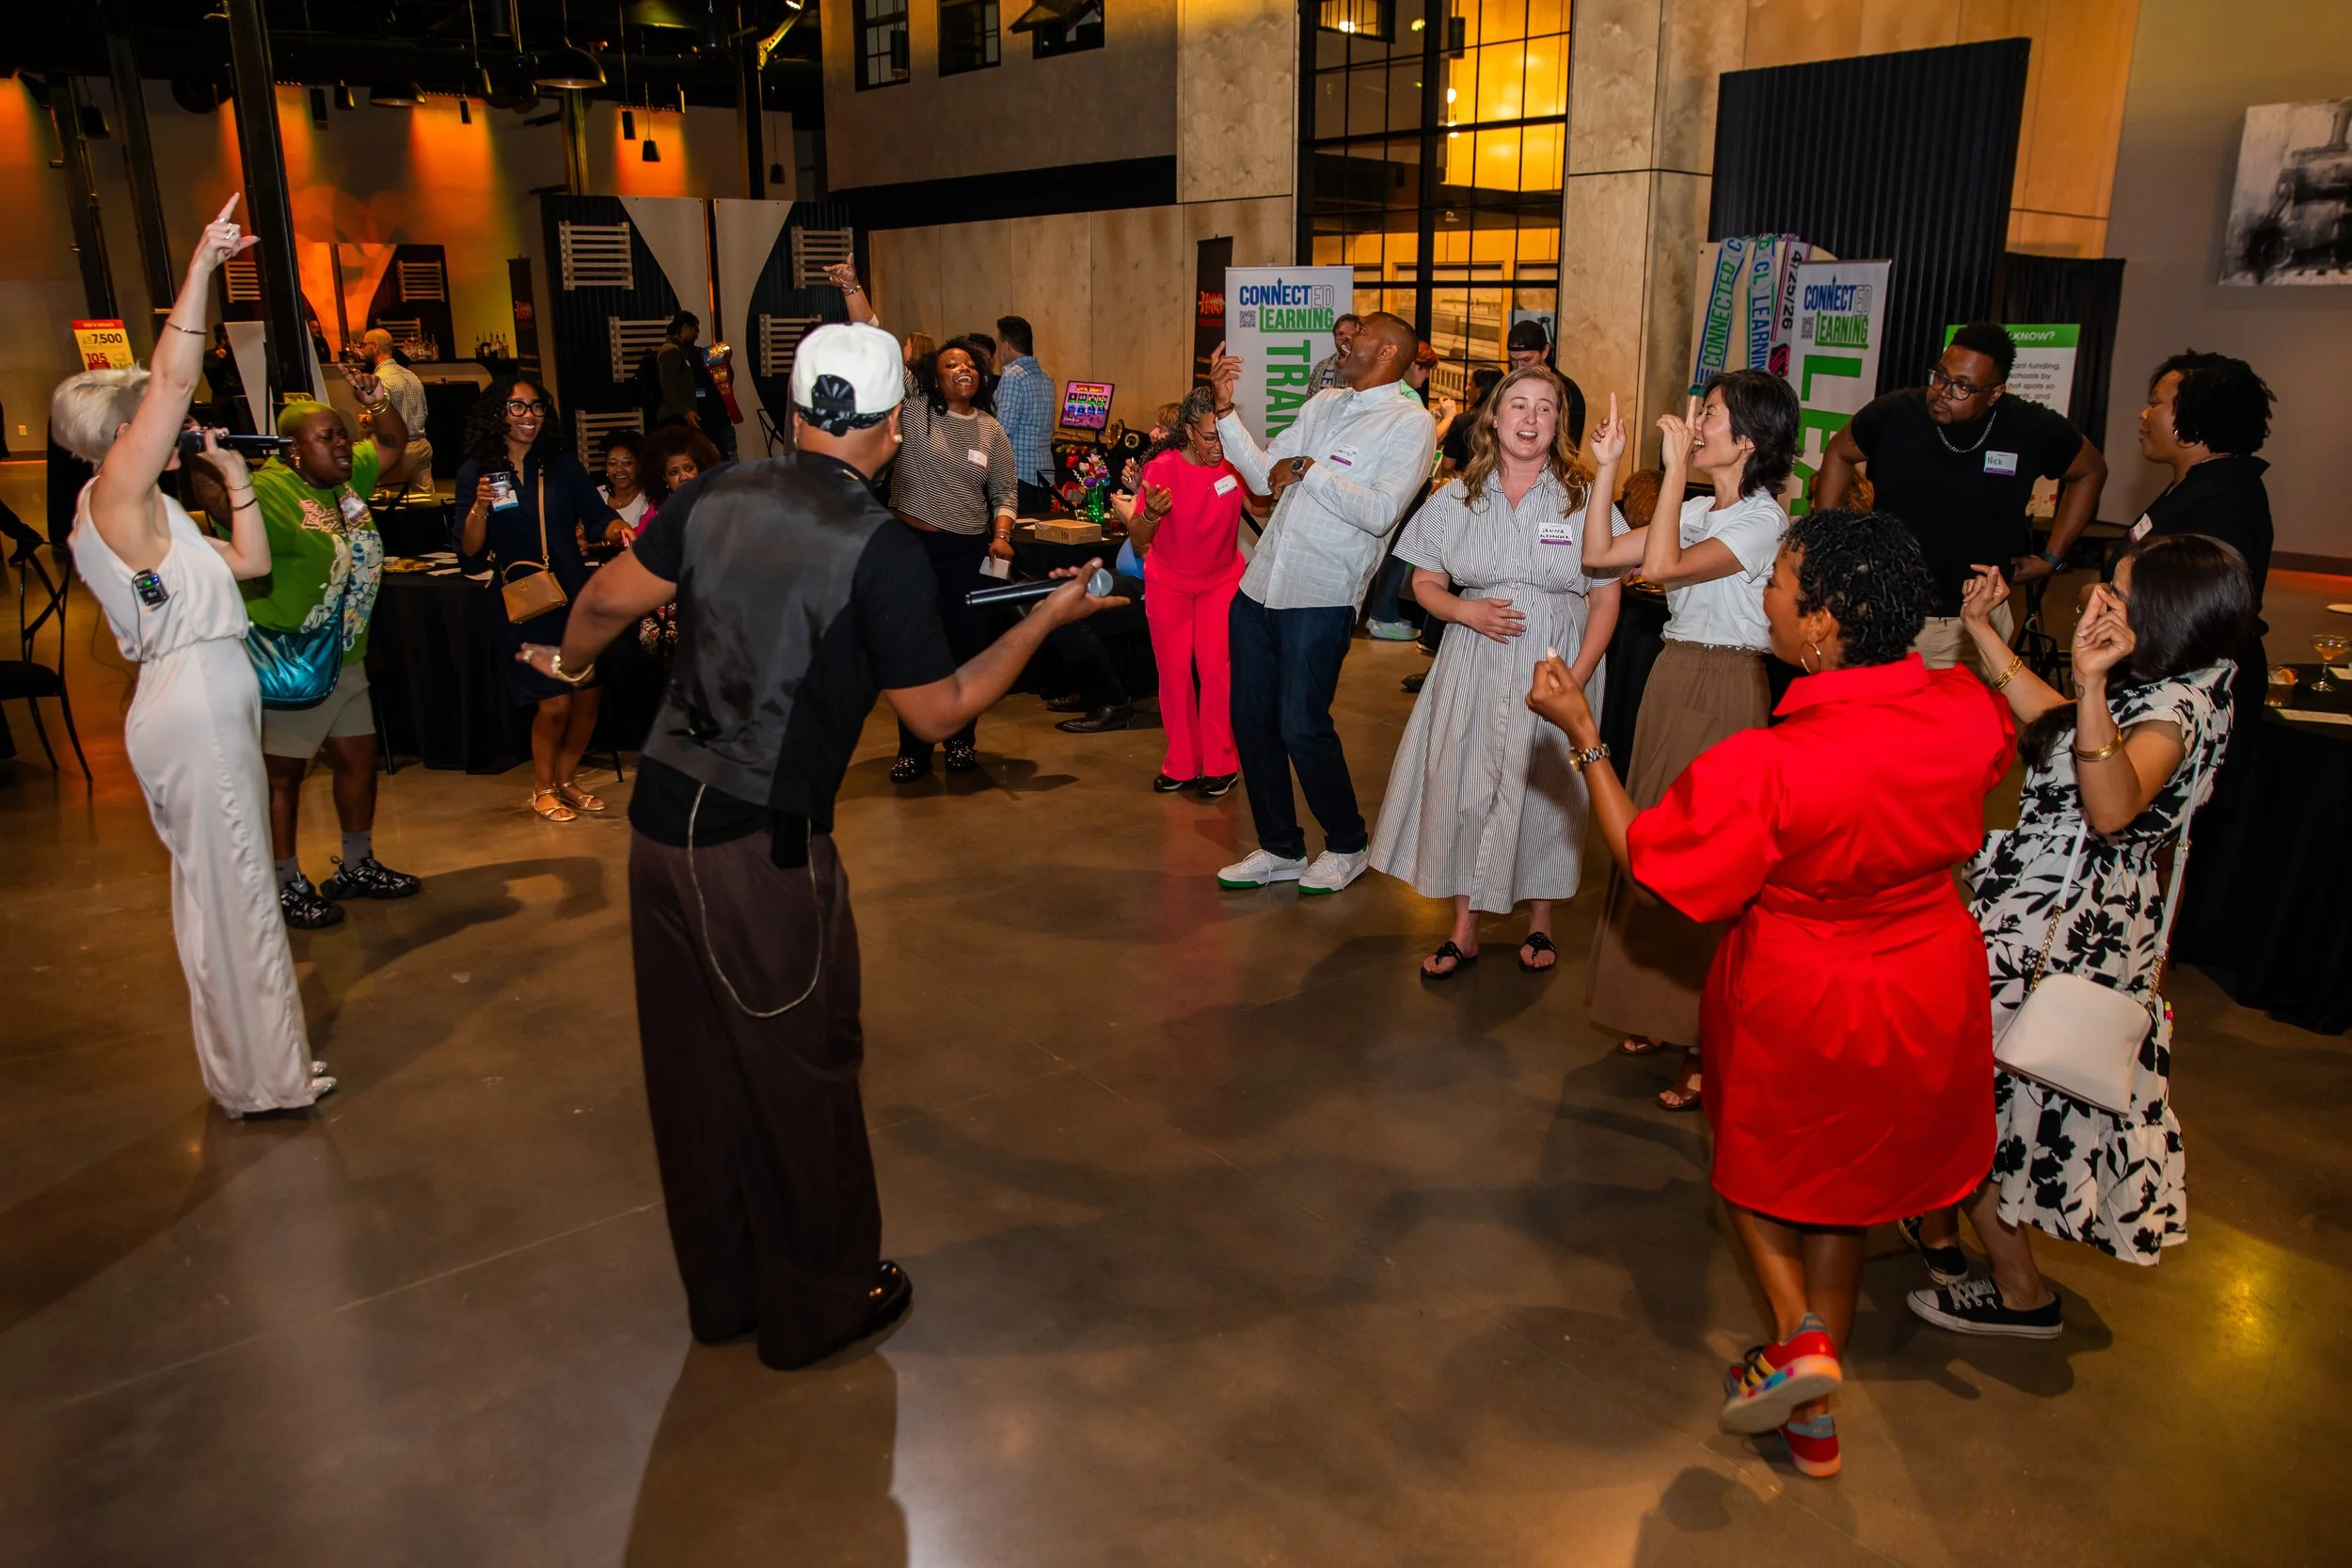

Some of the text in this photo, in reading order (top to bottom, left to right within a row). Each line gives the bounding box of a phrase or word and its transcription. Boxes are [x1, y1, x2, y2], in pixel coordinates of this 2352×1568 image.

[1239, 284, 1335, 309] CONNECTED
[1781, 250, 1804, 330] 4/25/26
[1804, 284, 1873, 317] CONNECTED
[1259, 302, 1334, 333] LEARNING
[1702, 260, 1736, 368] CONNECTED
[1814, 309, 1870, 349] LEARNING
[91, 333, 122, 345] 7,500
[2013, 331, 2056, 341] KNOW?
[1987, 456, 2003, 466] Nick
